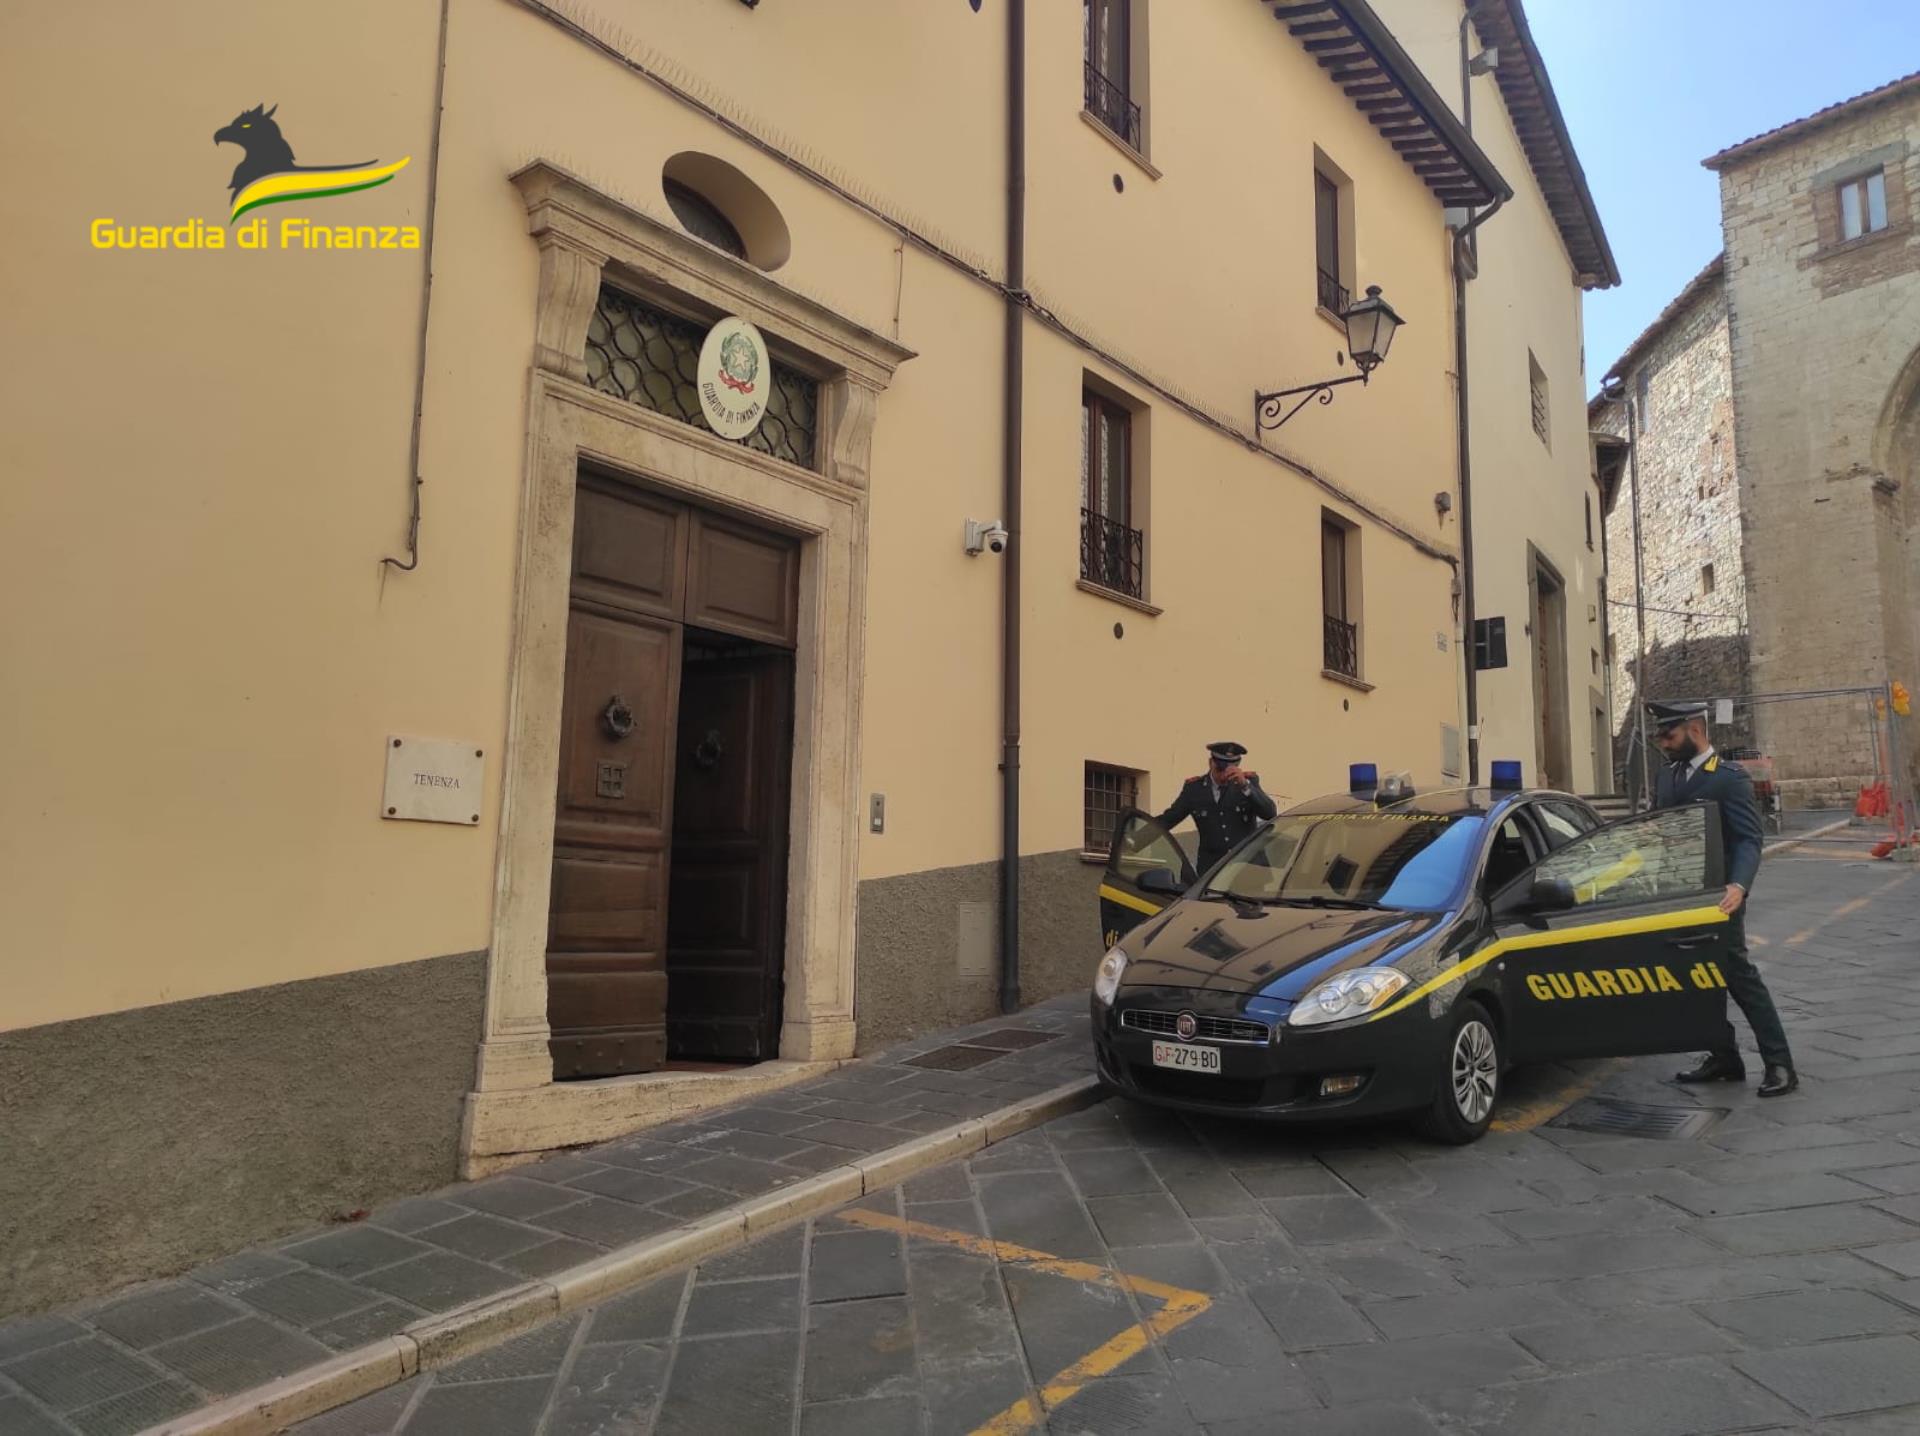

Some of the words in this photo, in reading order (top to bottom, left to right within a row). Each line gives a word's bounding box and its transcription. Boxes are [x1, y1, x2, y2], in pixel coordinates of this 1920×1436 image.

[702, 382, 726, 418] GUARDIA
[726, 410, 734, 425] DI
[413, 773, 461, 790] TENENZA
[1526, 965, 1683, 1001] GUARDIA
[1690, 961, 1728, 989] di
